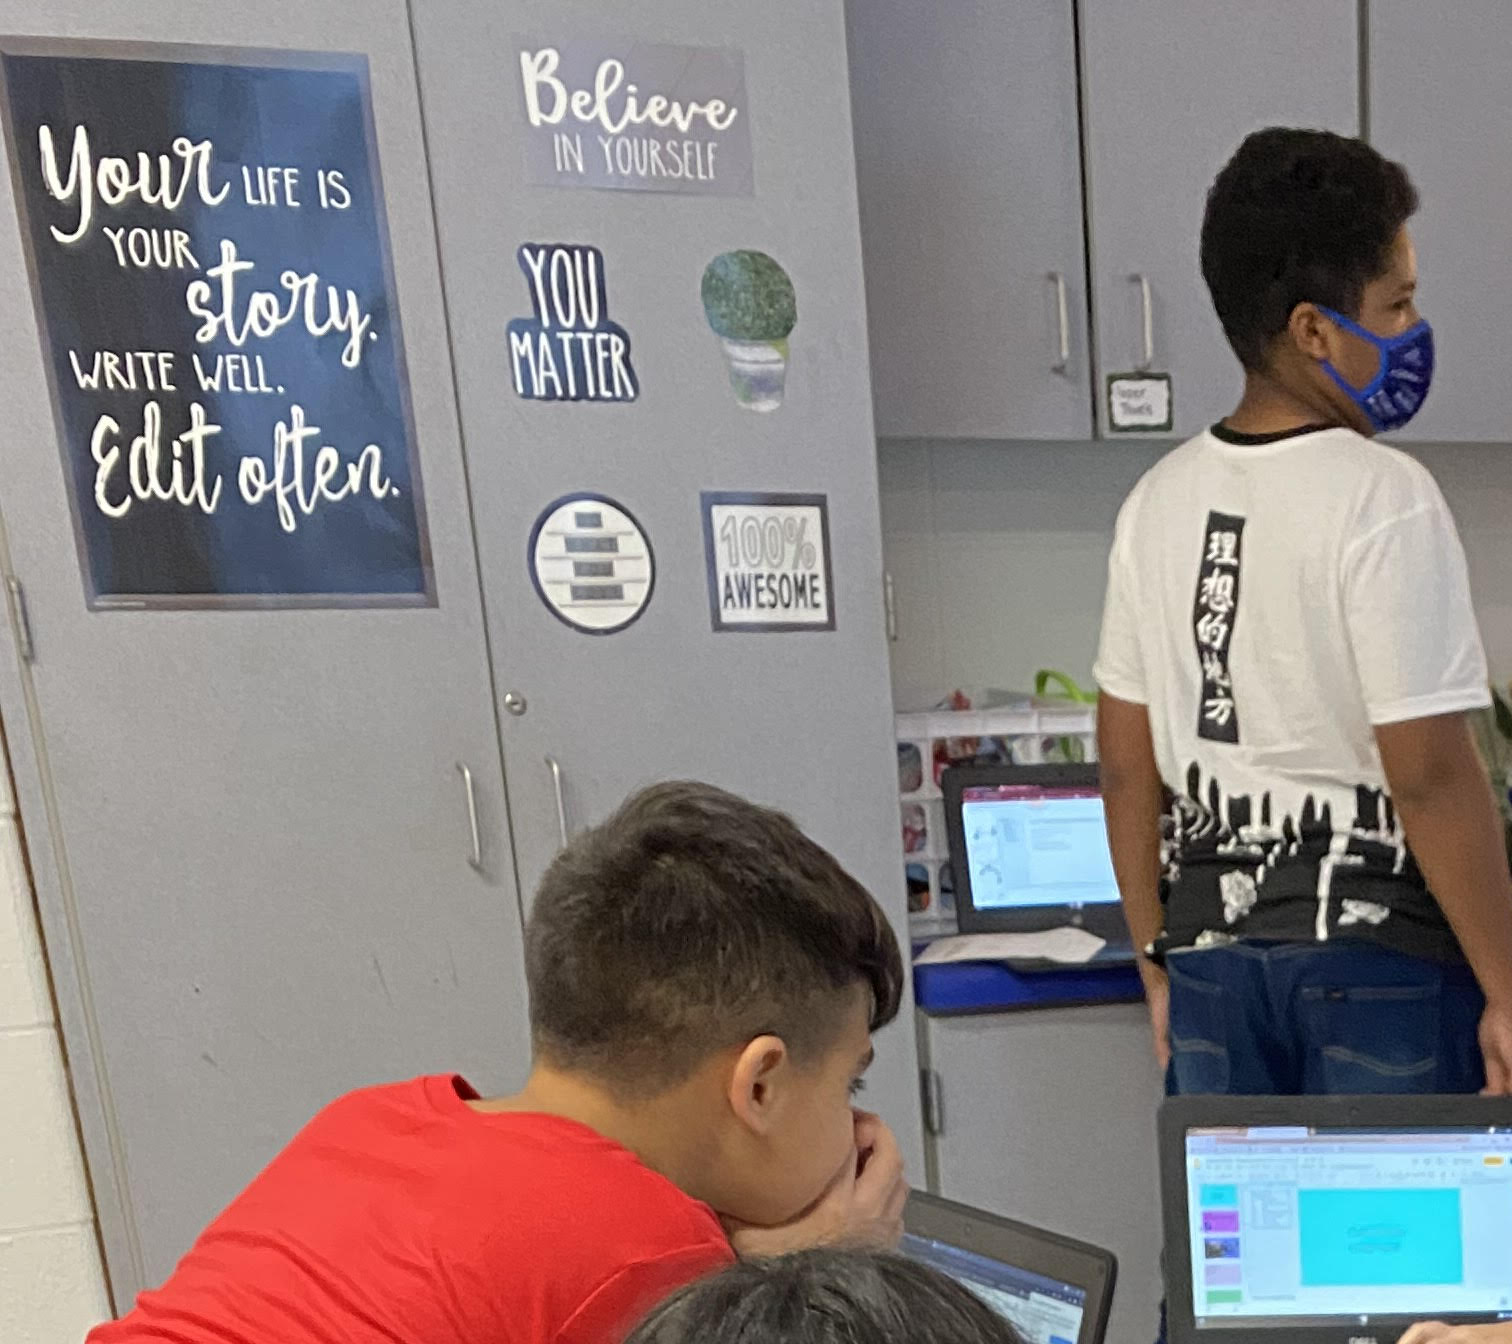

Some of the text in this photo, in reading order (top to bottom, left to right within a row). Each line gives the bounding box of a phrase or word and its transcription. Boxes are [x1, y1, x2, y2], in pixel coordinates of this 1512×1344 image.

[519, 47, 738, 134] Believe
[38, 125, 352, 244] Your LIFE IS
[553, 135, 719, 181] IN YOURSELF
[103, 226, 199, 270] YOUR
[186, 239, 380, 369] story.
[521, 246, 600, 329] YOU
[68, 351, 285, 395] WRITE WELL.
[510, 330, 638, 400] MATTER
[91, 402, 400, 533] Edit often.
[718, 513, 818, 572] 100%
[722, 571, 823, 612] AWESOME
